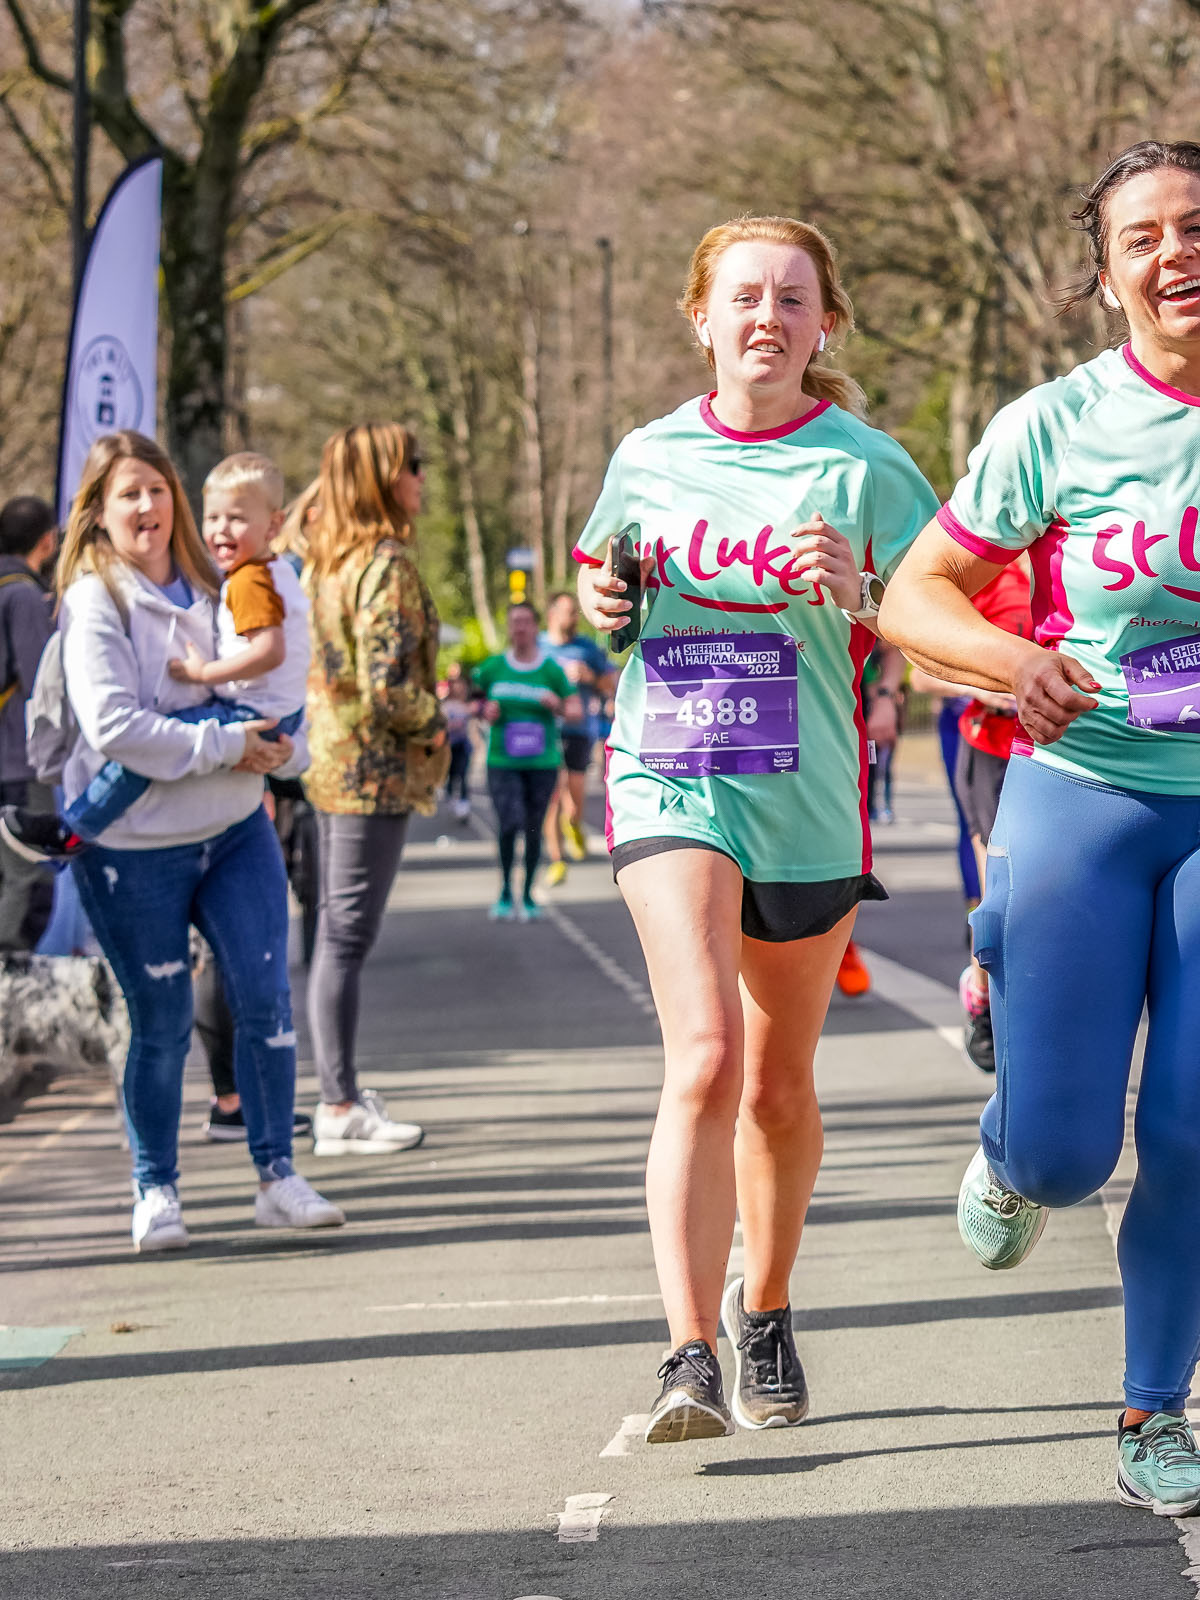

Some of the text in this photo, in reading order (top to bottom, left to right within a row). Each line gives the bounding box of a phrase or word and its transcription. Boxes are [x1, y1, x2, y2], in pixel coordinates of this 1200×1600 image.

[1092, 520, 1170, 591] St
[684, 643, 733, 655] SHEFFIELD
[686, 652, 779, 665] HALF MARATHON
[747, 663, 780, 675] 2022
[676, 697, 758, 727] 4388
[703, 732, 730, 744] FAE
[660, 762, 675, 770] FOR
[676, 762, 689, 770] ALL
